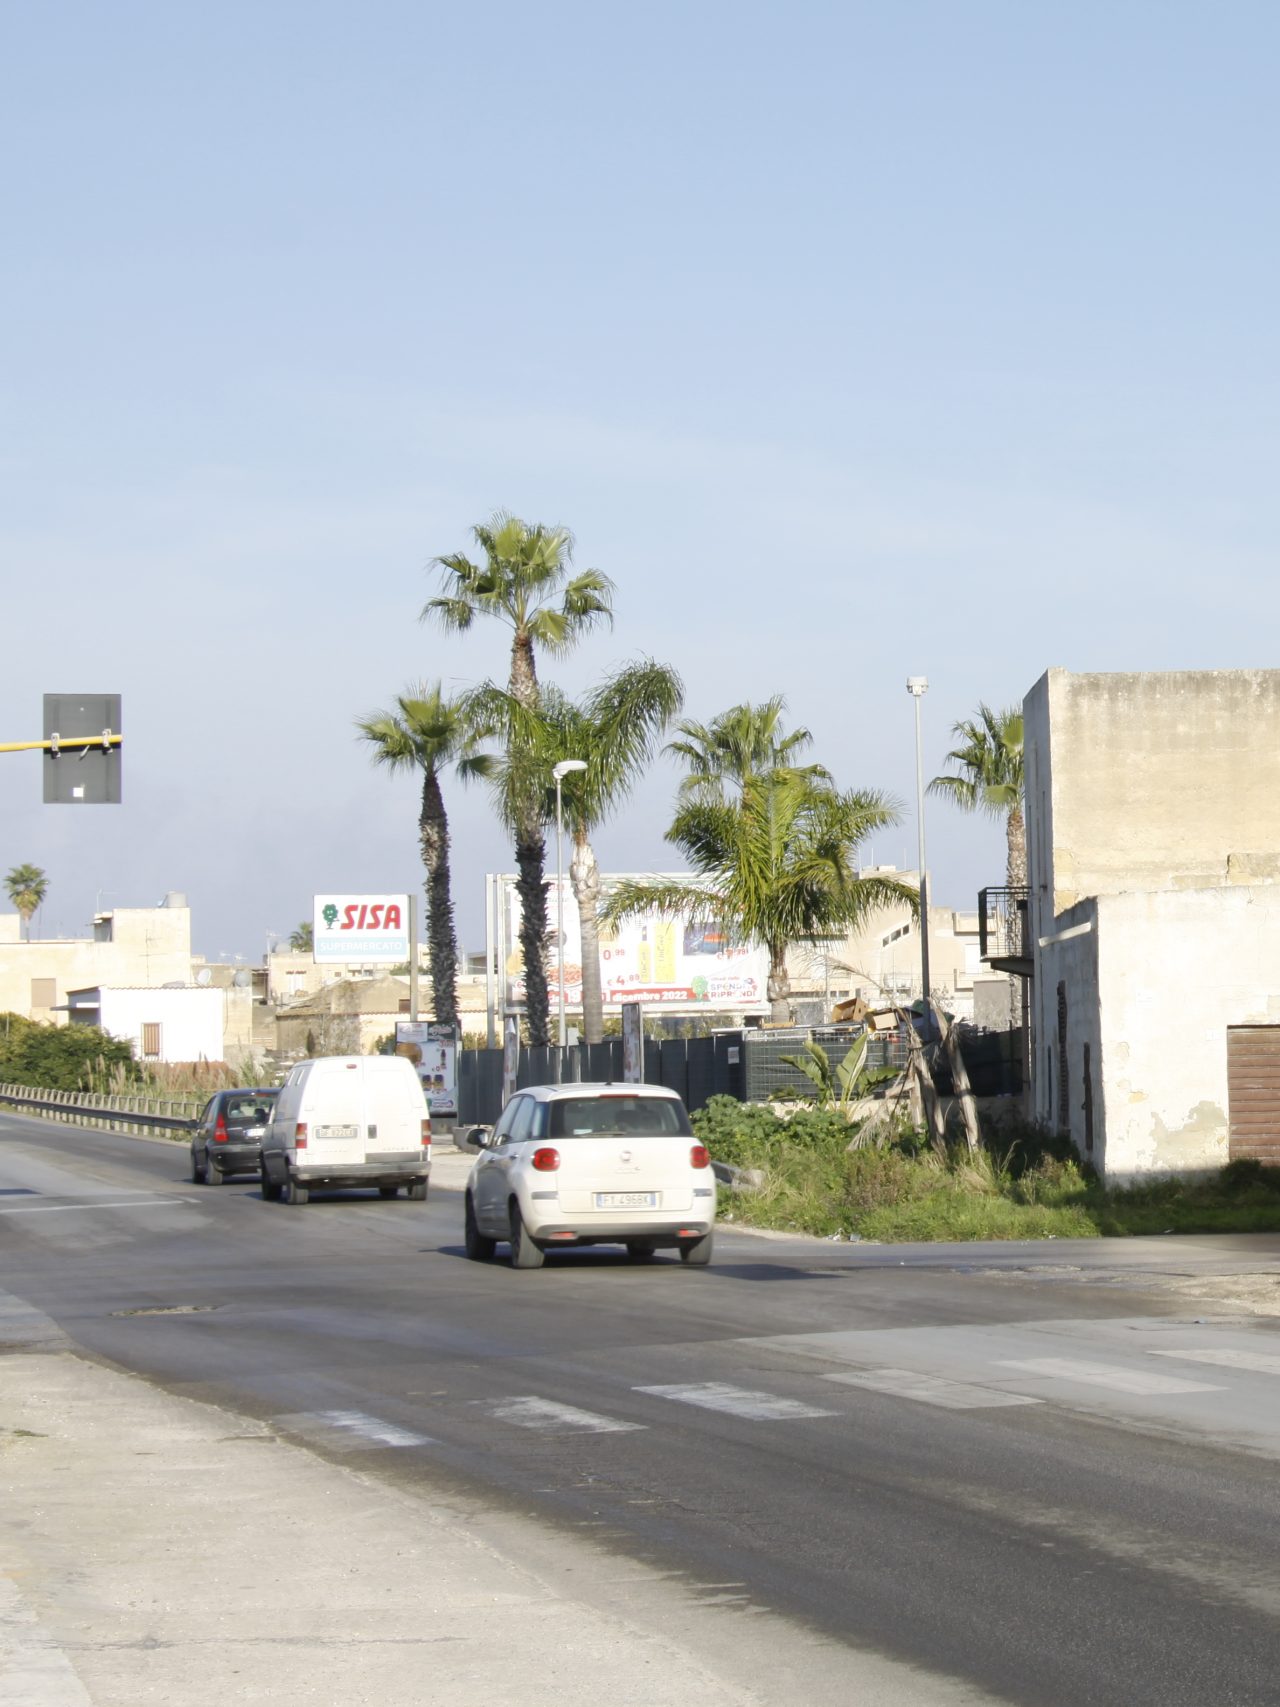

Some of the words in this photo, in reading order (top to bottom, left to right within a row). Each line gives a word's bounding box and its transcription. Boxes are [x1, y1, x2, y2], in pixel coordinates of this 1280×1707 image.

[340, 904, 401, 930] SISA
[320, 941, 402, 953] SUPERMERCATO
[612, 992, 661, 1003] dicembre
[662, 991, 688, 1001] 2022
[711, 991, 756, 999] RIPRNDI
